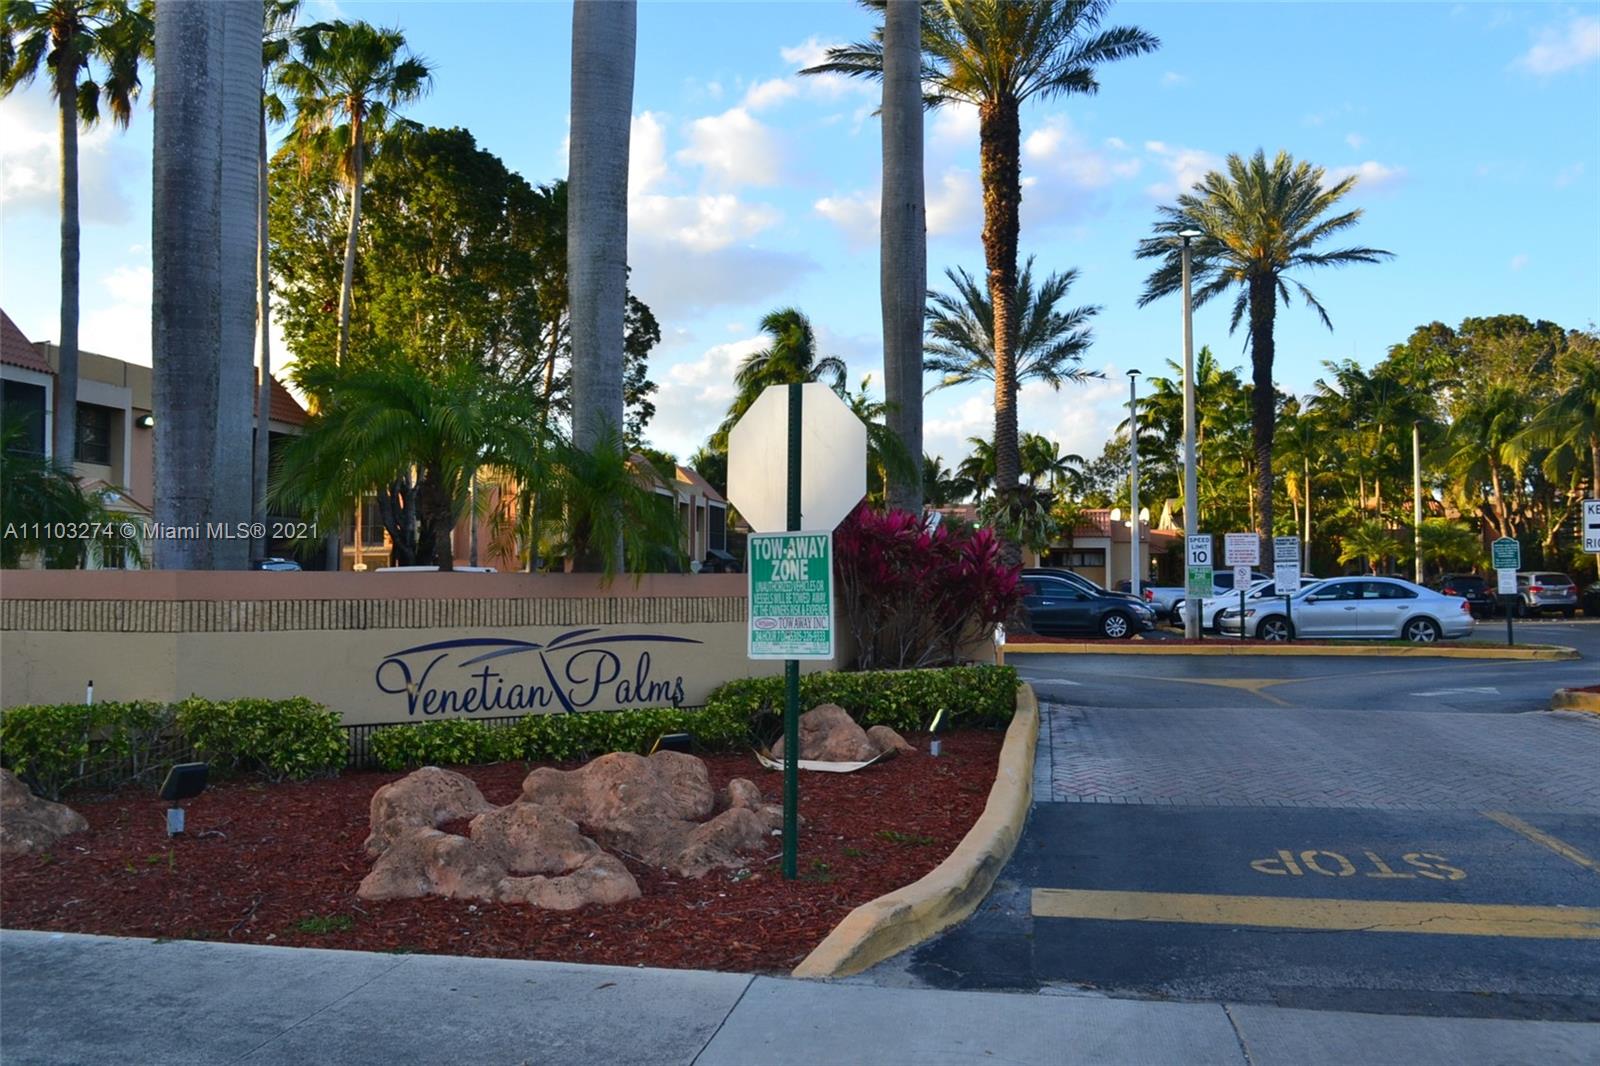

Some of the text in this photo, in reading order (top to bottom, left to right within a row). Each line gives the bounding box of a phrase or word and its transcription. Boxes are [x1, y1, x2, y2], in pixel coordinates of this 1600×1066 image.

[753, 537, 826, 560] TOW-AWAY
[1192, 551, 1208, 563] 10
[771, 559, 809, 581] ZONE
[793, 580, 816, 592] VEHICLES
[779, 617, 794, 629] TOW
[794, 617, 812, 629] AWAY
[376, 649, 685, 715] Venetian Palms
[1249, 849, 1468, 880] STOP
